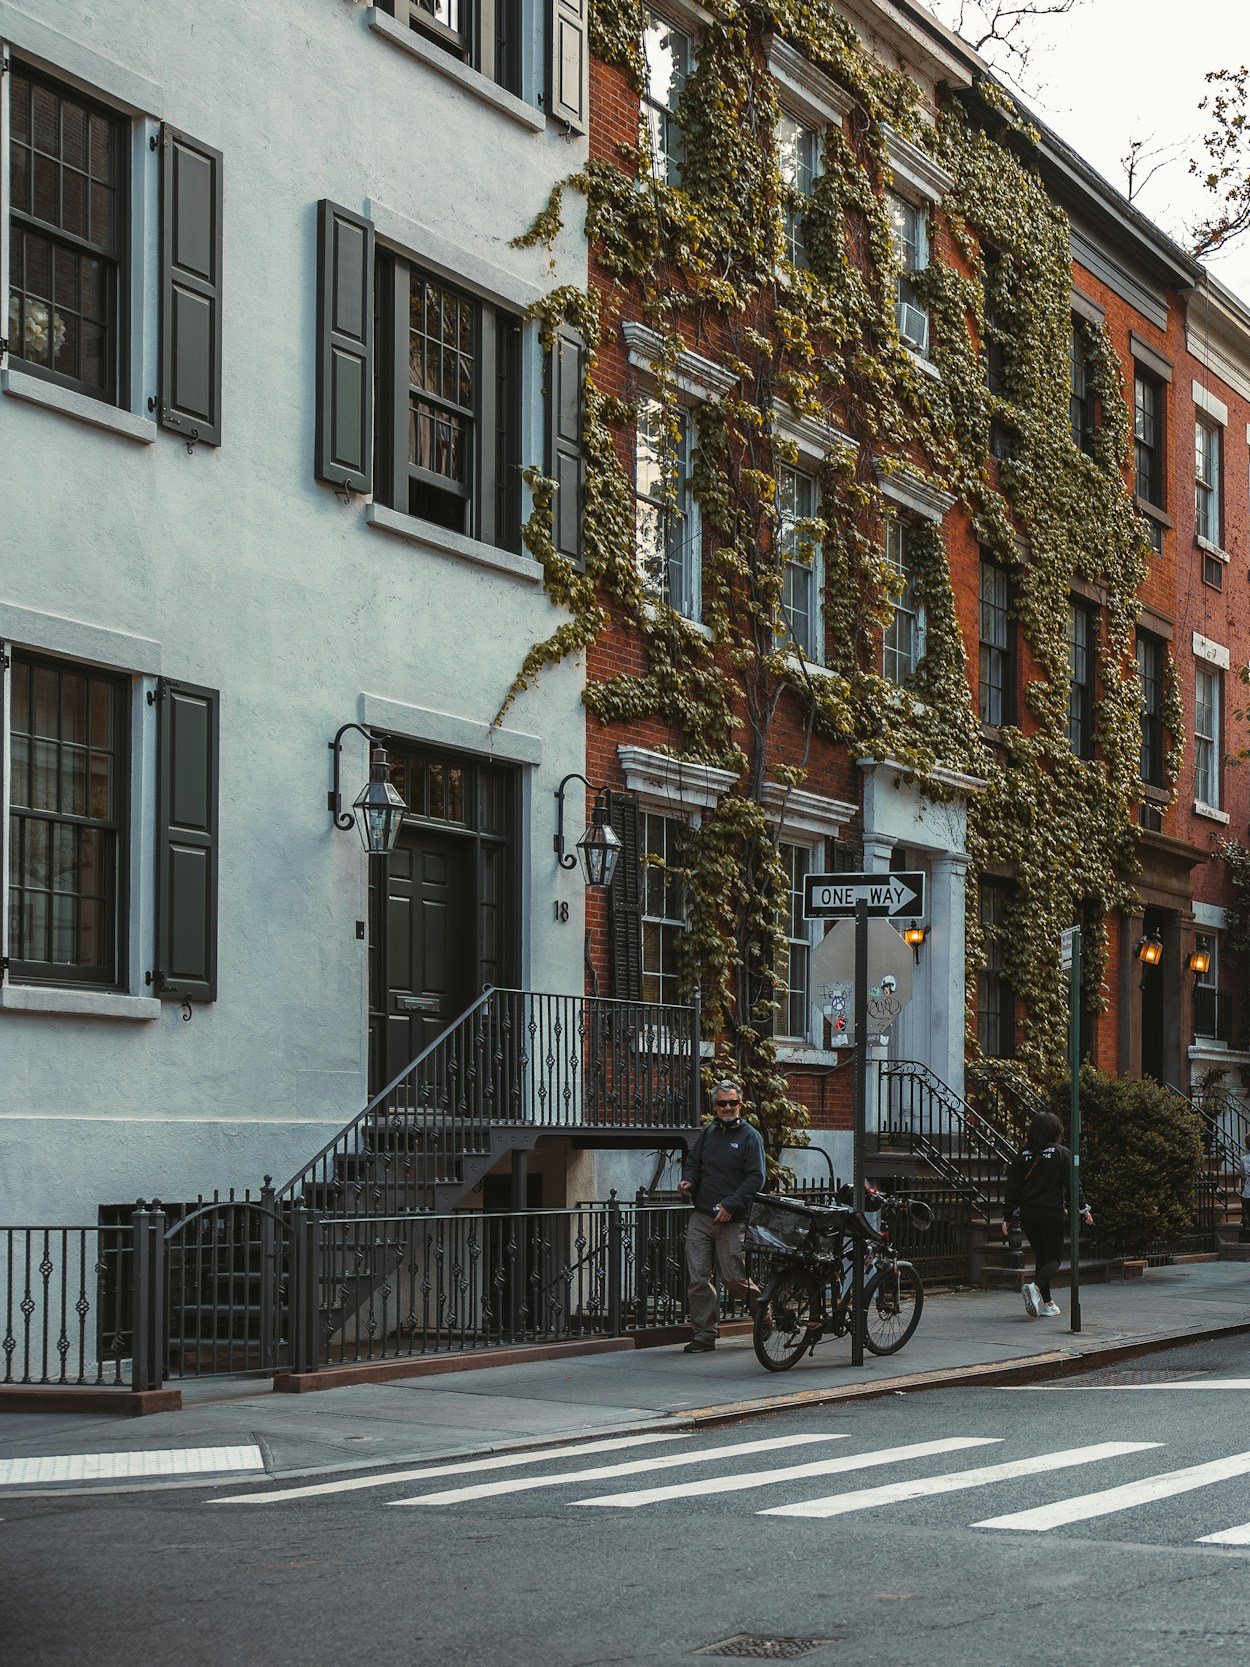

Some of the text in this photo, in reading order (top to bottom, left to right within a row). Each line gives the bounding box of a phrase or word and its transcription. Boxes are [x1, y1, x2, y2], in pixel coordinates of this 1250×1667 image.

[821, 887, 905, 905] ONE WAY
[553, 899, 569, 922] 18
